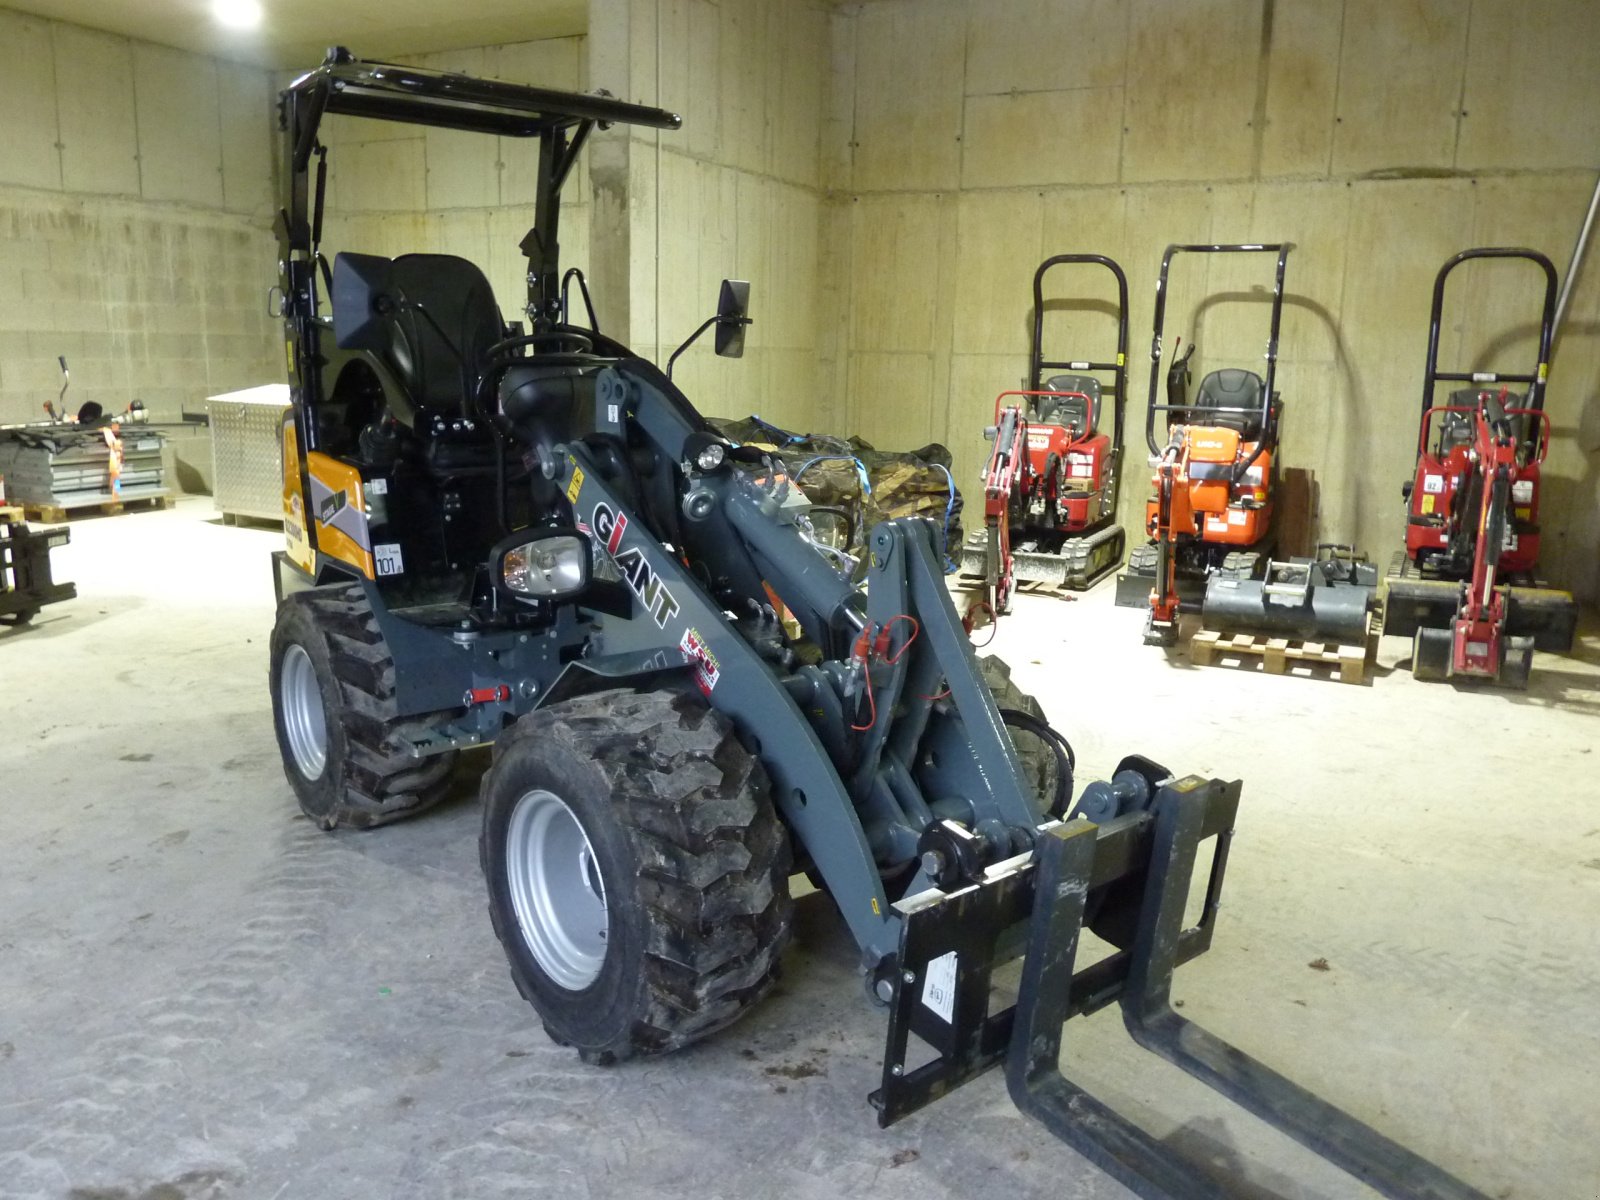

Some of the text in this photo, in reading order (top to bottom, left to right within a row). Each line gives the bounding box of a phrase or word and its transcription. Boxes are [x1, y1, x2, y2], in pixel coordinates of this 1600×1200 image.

[377, 556, 395, 575] 101
[689, 627, 705, 646] MIET
[687, 632, 716, 676] WSU
